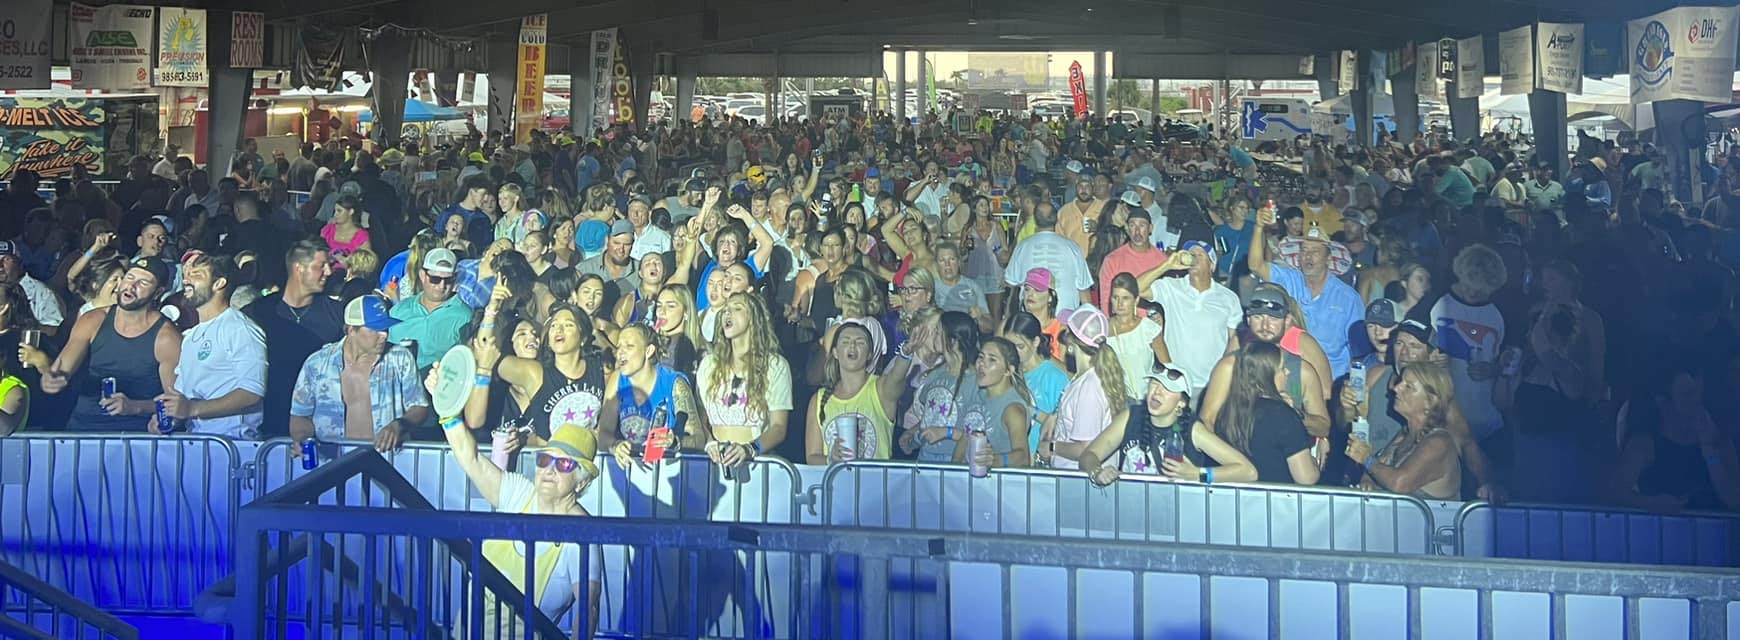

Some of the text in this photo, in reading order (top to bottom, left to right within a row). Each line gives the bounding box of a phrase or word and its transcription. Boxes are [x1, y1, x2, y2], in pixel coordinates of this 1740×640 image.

[234, 13, 264, 39] REST
[525, 16, 545, 26] ICE
[521, 31, 545, 44] COLD
[231, 40, 264, 67] ROOMS
[522, 46, 540, 113] BEER
[52, 108, 99, 126] ICE
[22, 136, 86, 160] Take it
[543, 383, 579, 413] CHERRY
